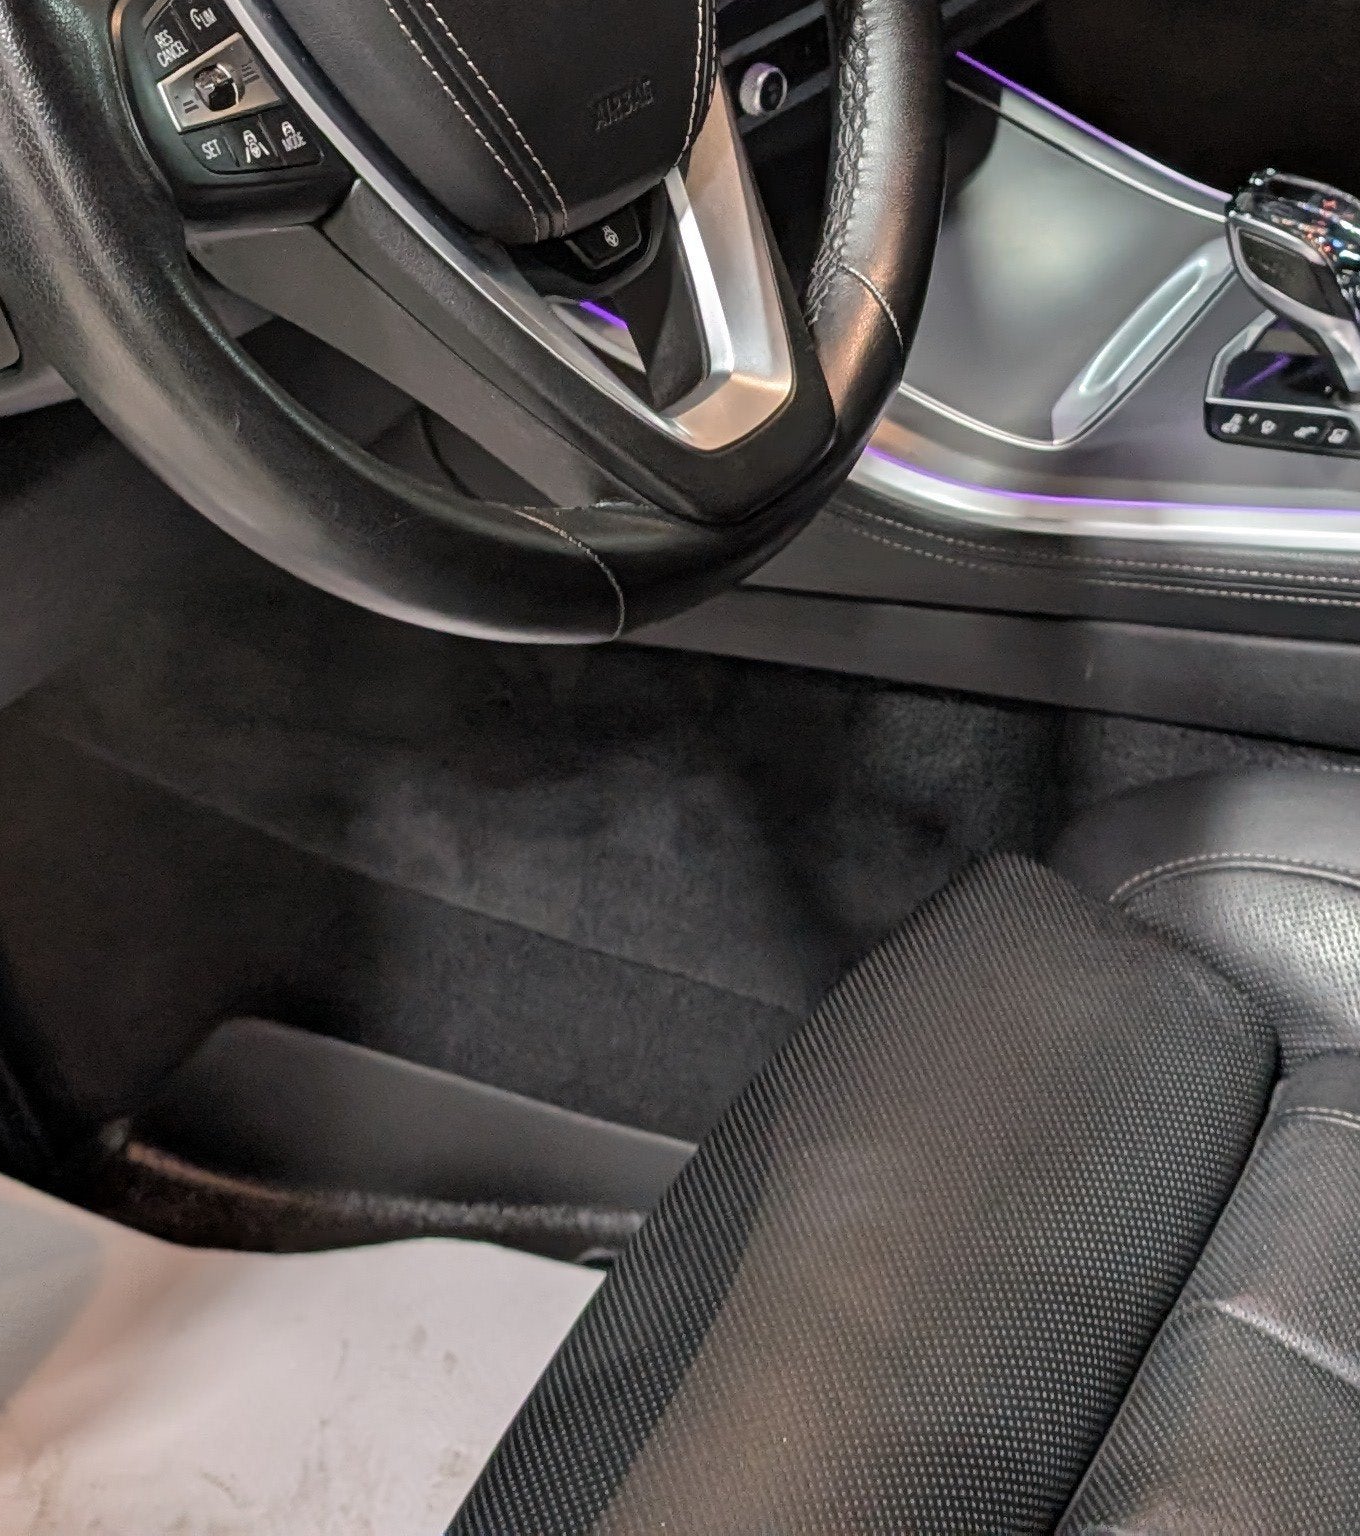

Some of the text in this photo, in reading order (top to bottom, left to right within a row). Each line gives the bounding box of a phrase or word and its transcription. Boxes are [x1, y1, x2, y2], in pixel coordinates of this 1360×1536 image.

[154, 29, 174, 49] RES
[156, 40, 189, 68] CANCEL
[201, 138, 222, 160] SET
